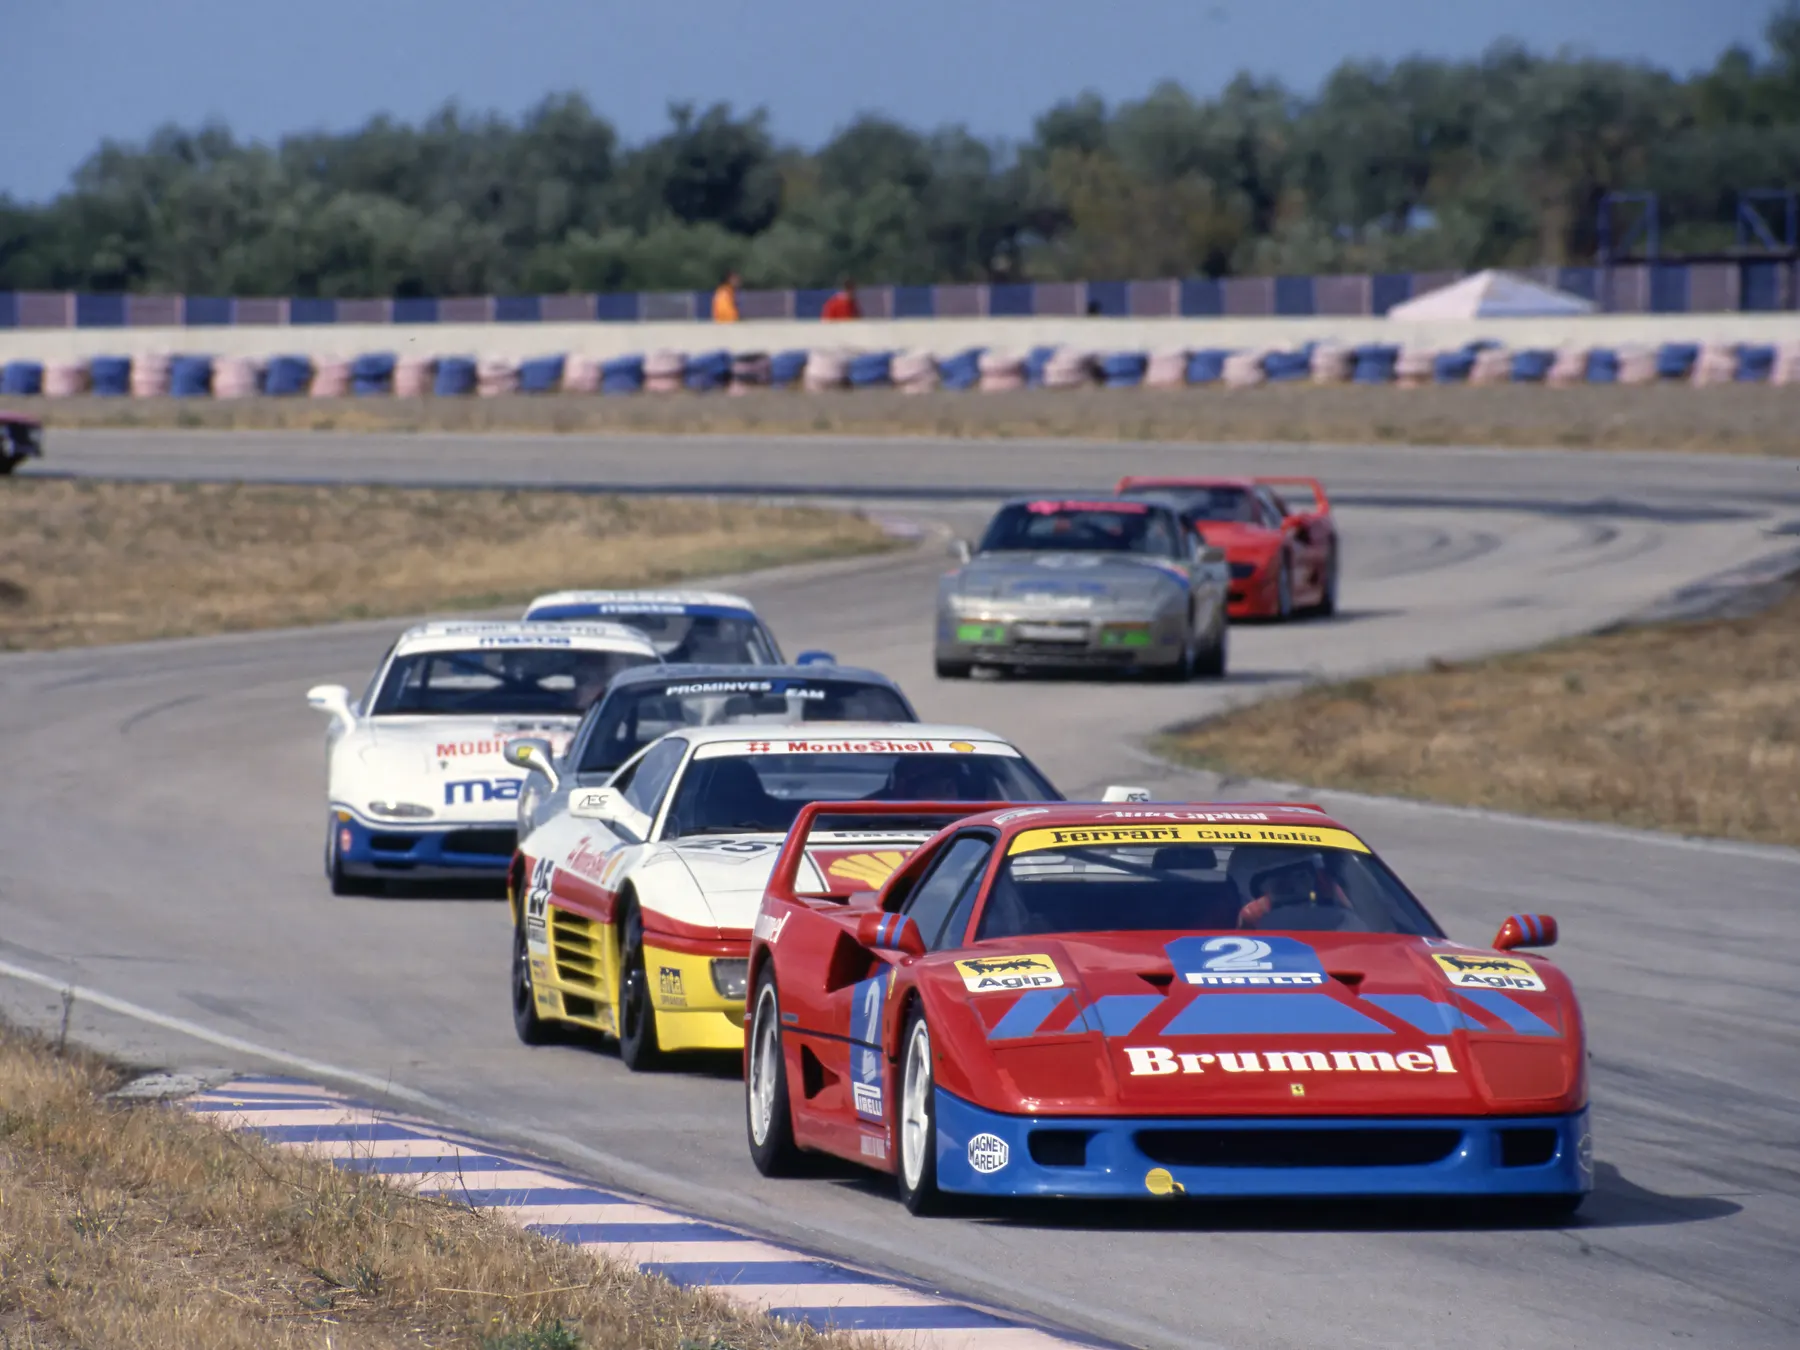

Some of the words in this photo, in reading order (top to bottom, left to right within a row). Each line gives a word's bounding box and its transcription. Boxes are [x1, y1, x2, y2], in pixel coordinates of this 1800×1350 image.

[788, 742, 935, 752] MonteShell
[1052, 827, 1182, 844] Ferrari
[1197, 830, 1253, 842] Club
[1201, 937, 1273, 971] 2
[978, 975, 1053, 989] Agip
[1461, 973, 1536, 988] Agip
[862, 980, 881, 1085] 2
[1123, 1045, 1459, 1076] Brummel
